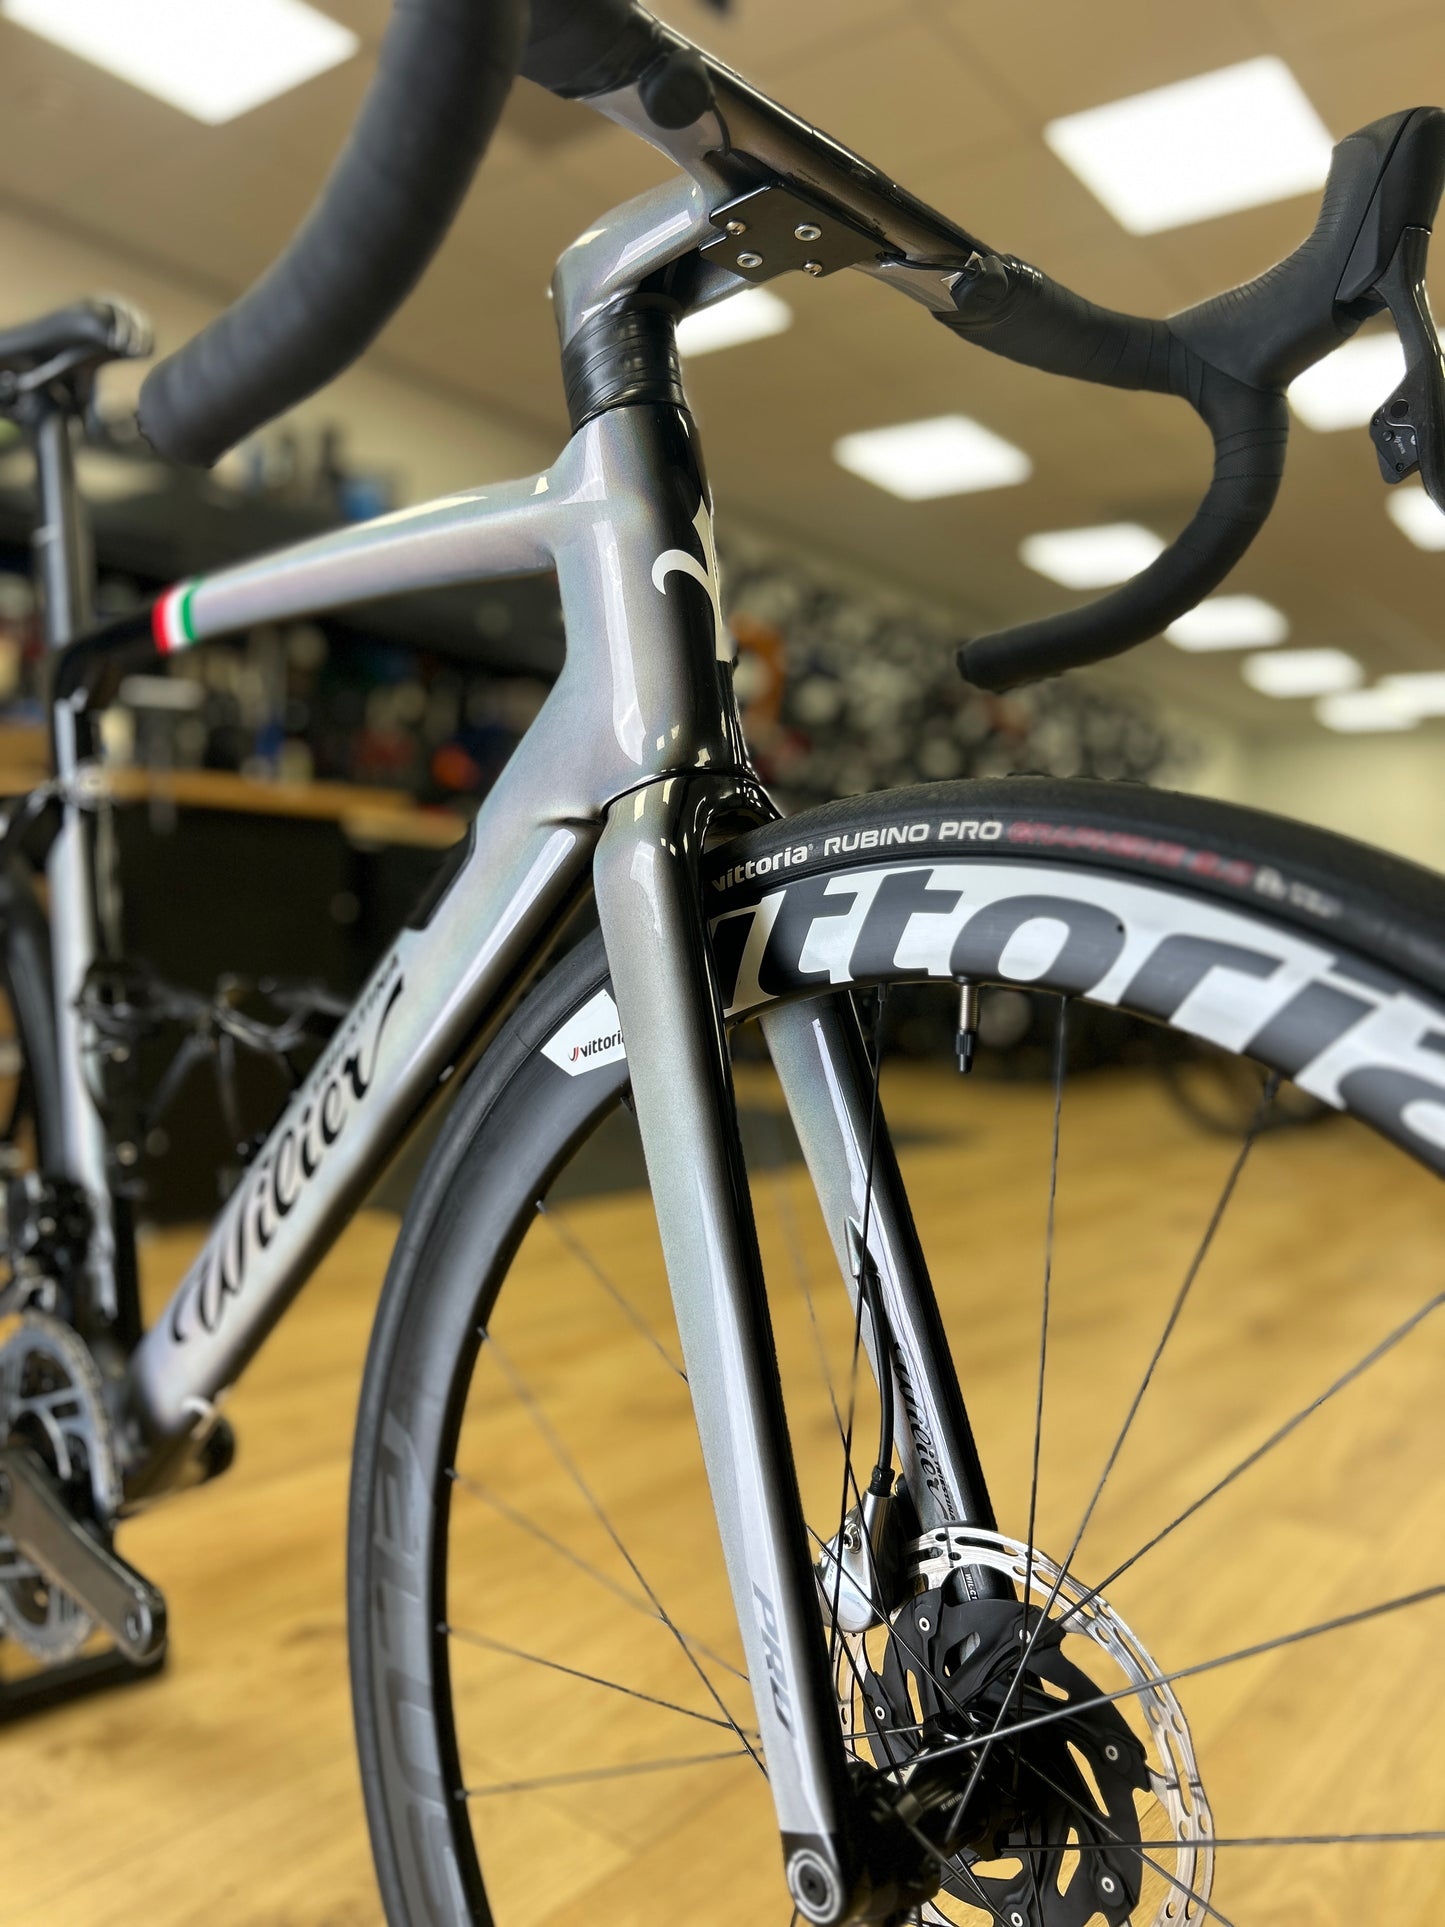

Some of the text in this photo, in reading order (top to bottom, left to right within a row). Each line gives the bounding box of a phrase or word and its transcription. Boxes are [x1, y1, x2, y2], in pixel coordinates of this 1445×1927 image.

[712, 844, 810, 892] vittoria
[824, 823, 930, 856] RUBINO
[938, 821, 1003, 841] PRO
[580, 1029, 625, 1058] vittori
[710, 868, 1445, 1175] ittori
[170, 972, 403, 1345] Wilier
[893, 1341, 950, 1521] Wilier
